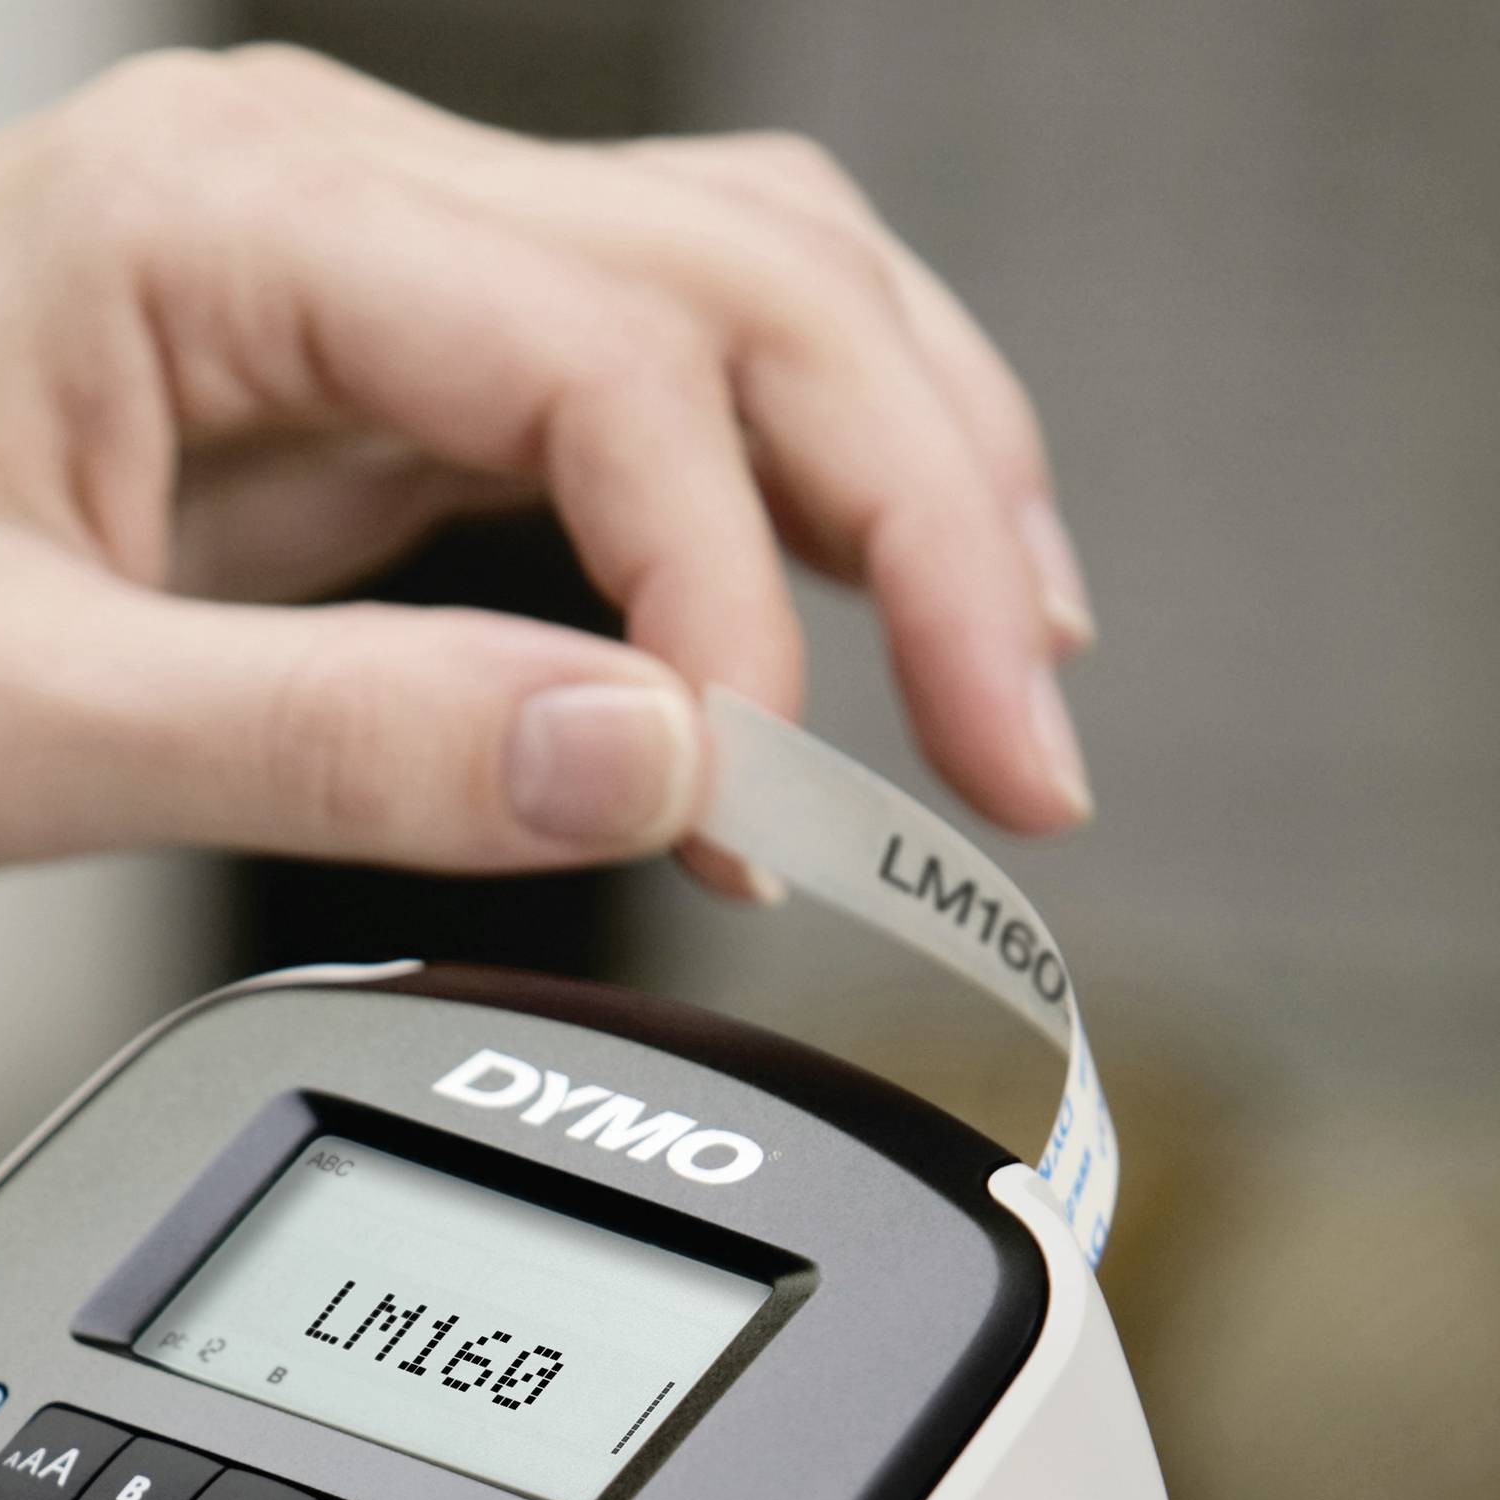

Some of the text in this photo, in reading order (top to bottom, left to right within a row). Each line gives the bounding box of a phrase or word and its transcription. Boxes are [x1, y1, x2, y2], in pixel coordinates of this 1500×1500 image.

[878, 833, 1068, 1004] LM160
[306, 1151, 355, 1176] ABC
[431, 1048, 764, 1185] DYMO
[266, 1366, 287, 1384] B
[304, 1280, 564, 1411] LM160
